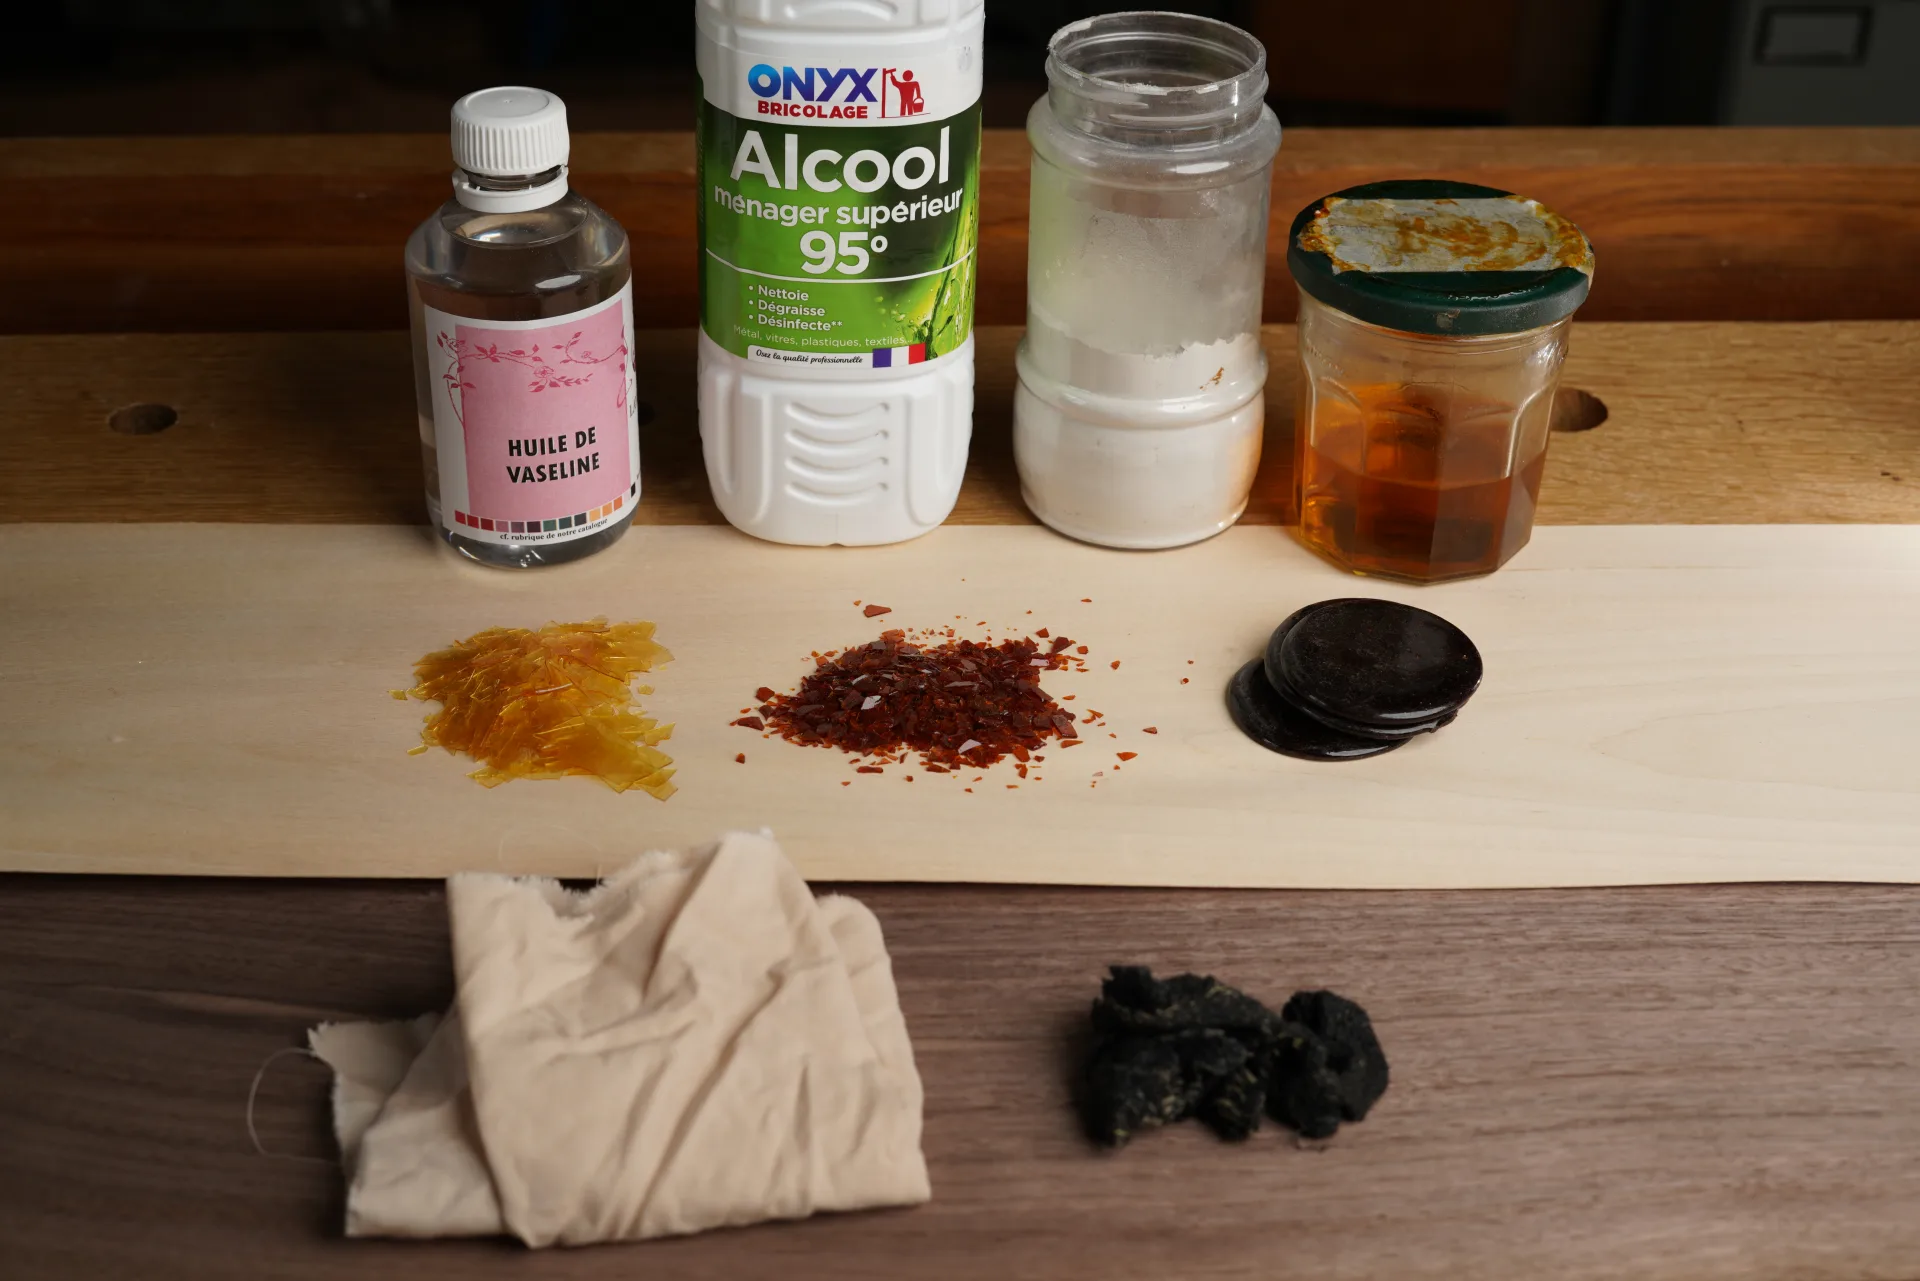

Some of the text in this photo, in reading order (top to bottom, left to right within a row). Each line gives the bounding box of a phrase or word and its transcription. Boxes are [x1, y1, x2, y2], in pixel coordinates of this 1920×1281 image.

[748, 63, 878, 102] ONYX
[757, 100, 868, 119] BRICOLAGE
[730, 125, 950, 193] Alcool
[714, 185, 963, 229] ménager supérieur
[758, 285, 809, 301] Nettoie
[758, 299, 825, 317] Dégraisse
[733, 324, 762, 341] Métal,
[765, 333, 799, 346] vitres,
[801, 336, 862, 348] plastiques,
[755, 349, 863, 365] Osez la qualité professionnelle
[508, 426, 597, 457] HUILE DE
[506, 452, 599, 483] VASELINE
[511, 533, 545, 541] rubrique
[546, 532, 556, 540] de
[557, 529, 577, 538] notre
[578, 518, 608, 532] catalogue
